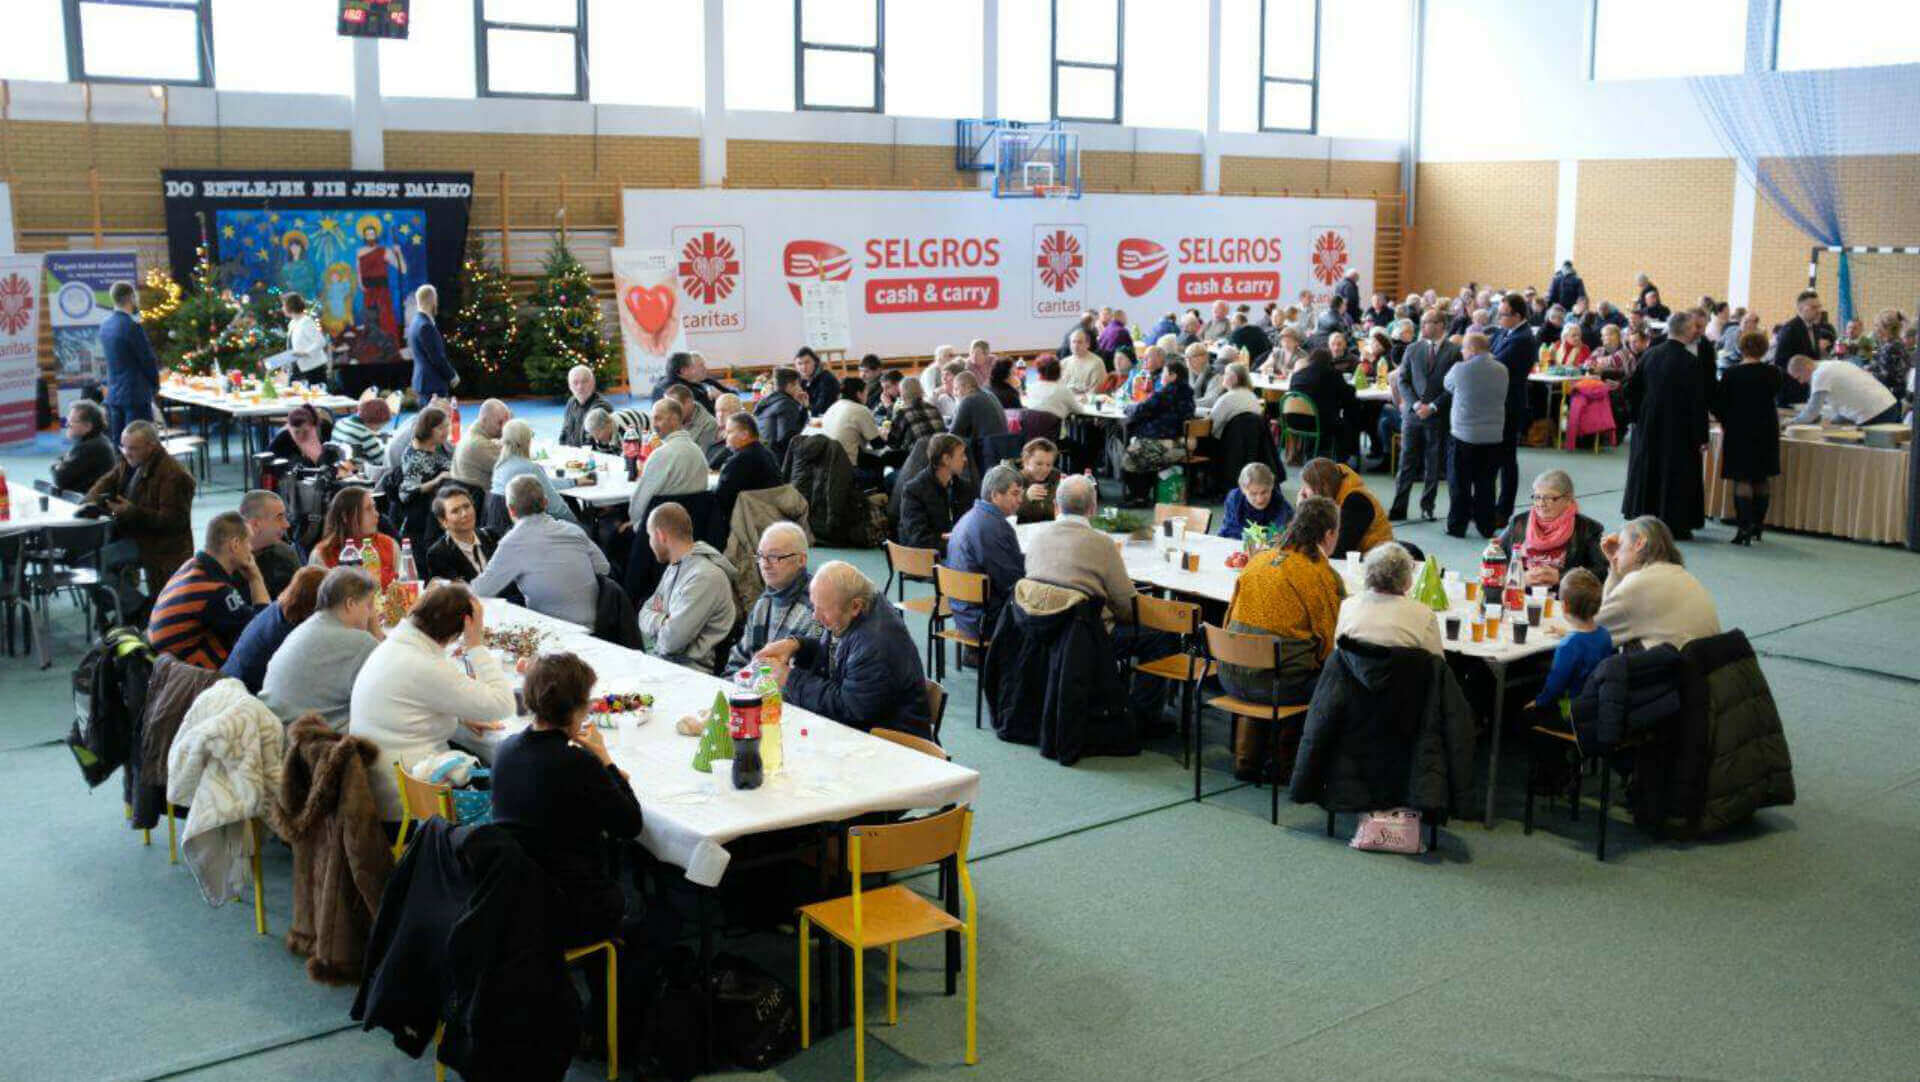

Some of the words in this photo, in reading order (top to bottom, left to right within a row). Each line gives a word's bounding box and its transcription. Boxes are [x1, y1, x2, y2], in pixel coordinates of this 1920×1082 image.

[165, 180, 195, 198] DO
[311, 180, 347, 197] NIE
[351, 181, 400, 198] JEST
[404, 182, 472, 198] DALEKO
[864, 237, 1001, 269] SELGROS
[1177, 236, 1282, 265] SELGROS
[875, 284, 919, 305] cash
[924, 282, 937, 303] &
[941, 283, 991, 307] carry
[1185, 278, 1219, 296] cash
[1222, 276, 1234, 294] &
[1236, 277, 1275, 297] carry
[1036, 298, 1081, 315] caritas
[683, 310, 739, 329] caritas
[0, 342, 32, 359] aritas
